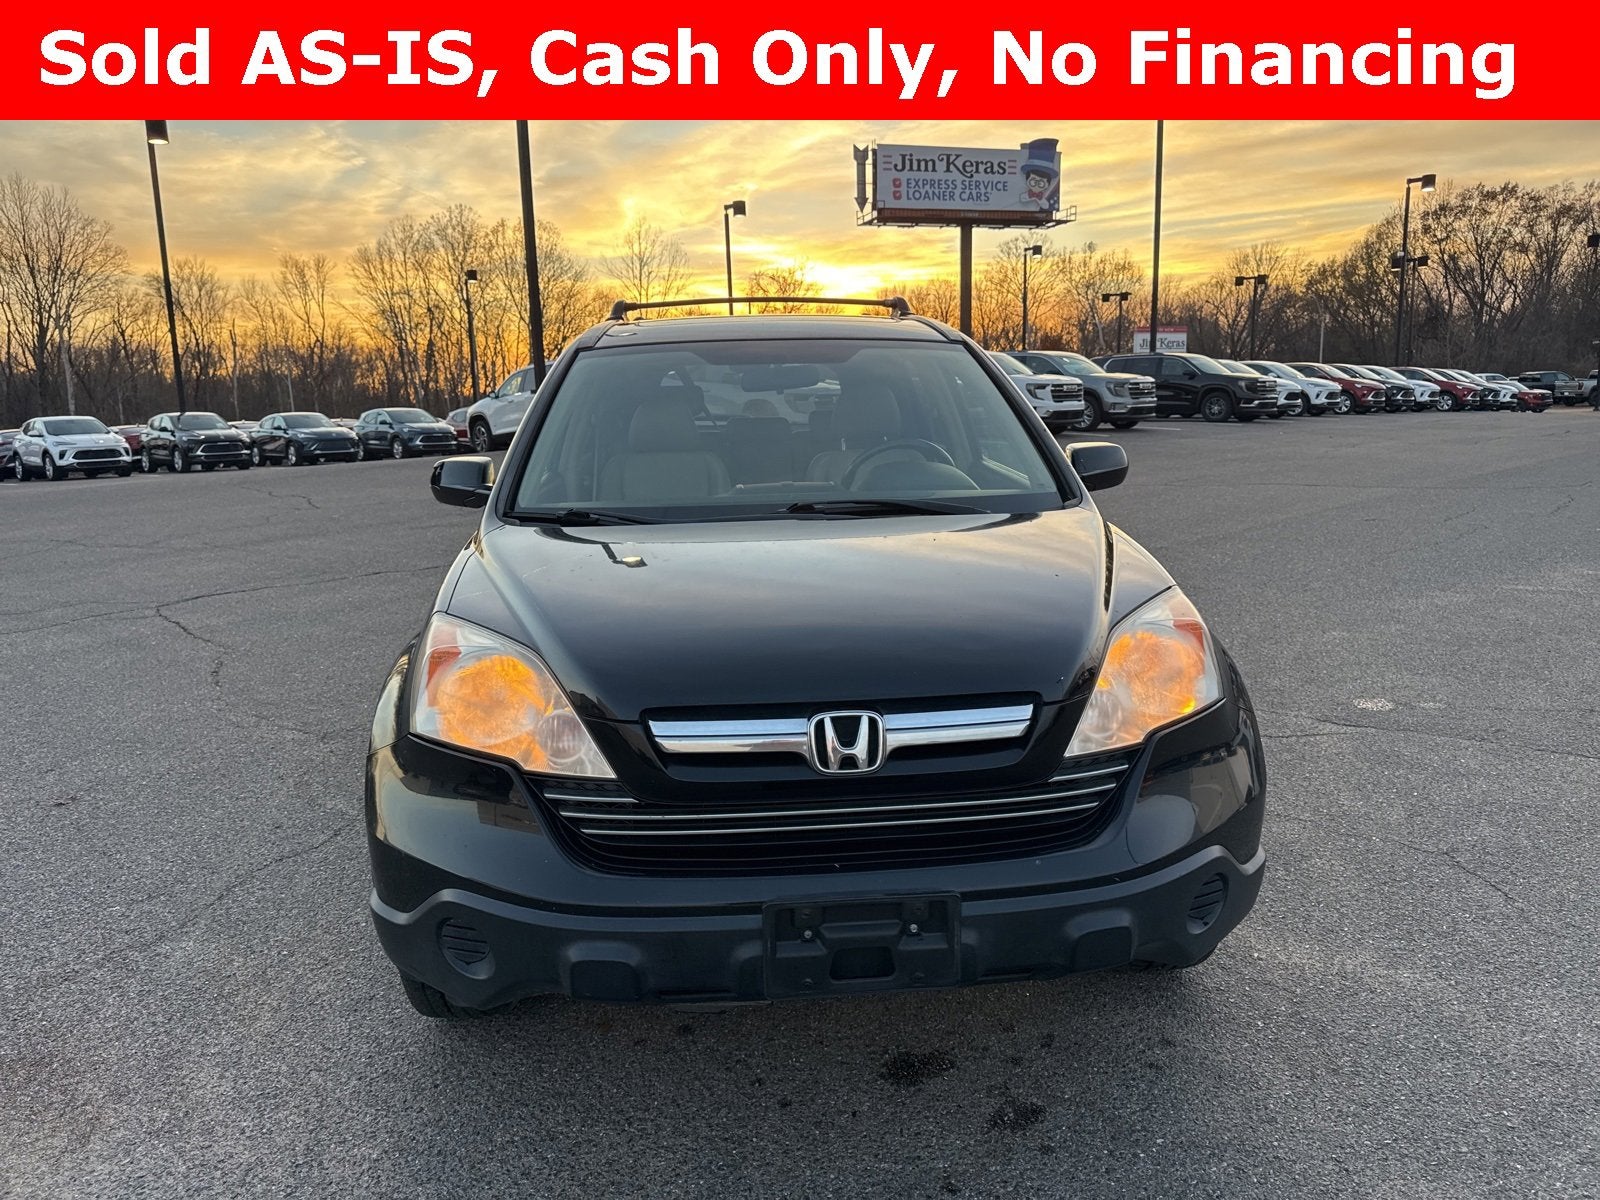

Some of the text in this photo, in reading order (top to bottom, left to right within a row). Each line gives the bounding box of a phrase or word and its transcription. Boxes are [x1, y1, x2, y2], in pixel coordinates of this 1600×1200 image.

[893, 153, 1007, 179] Jim Keras
[906, 178, 1009, 192] EXPRESS SERVICE
[906, 189, 956, 202] LOANER
